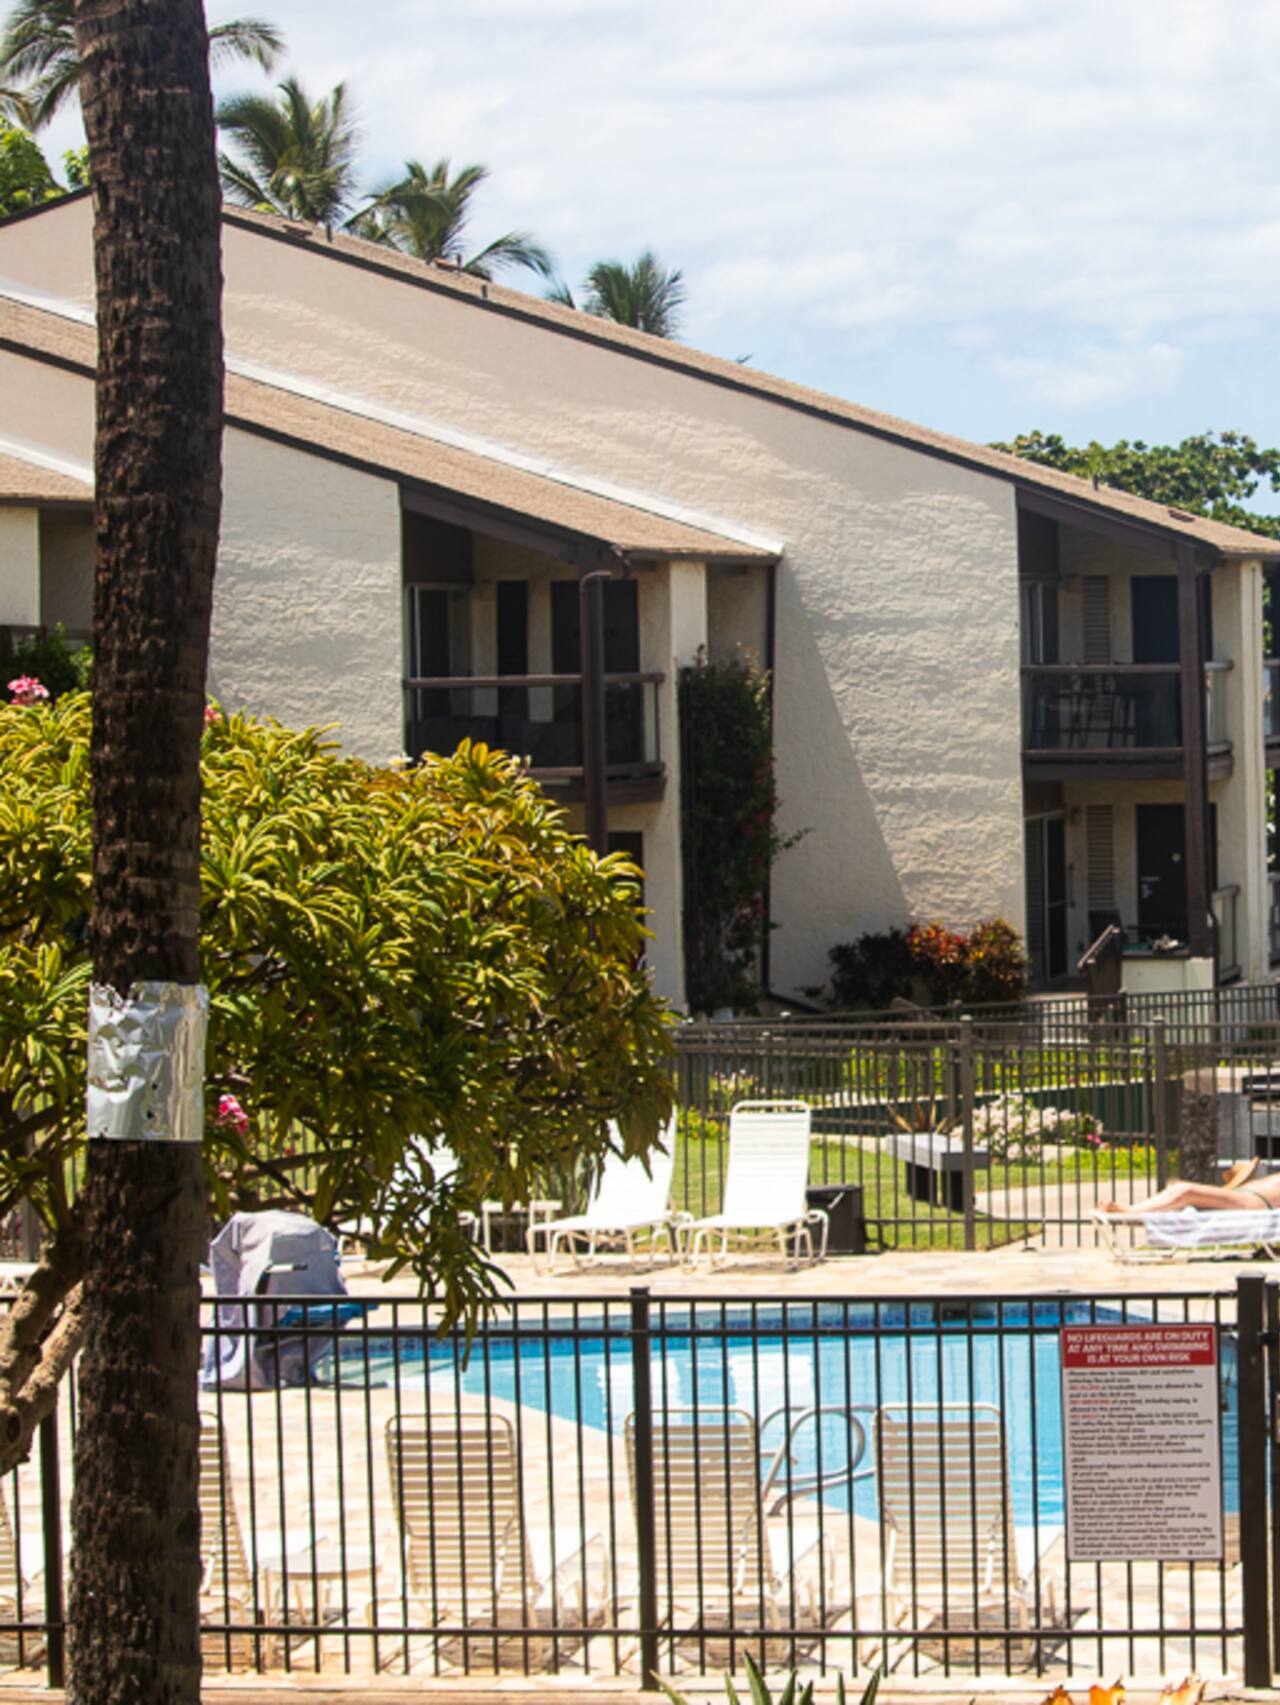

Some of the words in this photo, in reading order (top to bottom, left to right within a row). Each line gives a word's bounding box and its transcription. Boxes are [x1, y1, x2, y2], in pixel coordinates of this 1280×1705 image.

[1067, 1334, 1083, 1343] NO
[1084, 1332, 1141, 1343] LIFEGUARDS
[1144, 1332, 1162, 1342] ARE
[1164, 1331, 1179, 1341] ON
[1180, 1330, 1209, 1341] DUTY
[1067, 1344, 1081, 1353] AT
[1082, 1343, 1103, 1353] ANY
[1106, 1343, 1129, 1352] TIME
[1131, 1342, 1153, 1352] AND
[1154, 1341, 1210, 1352] SWIMMING
[1087, 1355, 1095, 1364] IS
[1095, 1354, 1110, 1363] AT
[1113, 1353, 1141, 1363] YOUR
[1142, 1353, 1166, 1363] OWN
[1168, 1352, 1191, 1362] RISK
